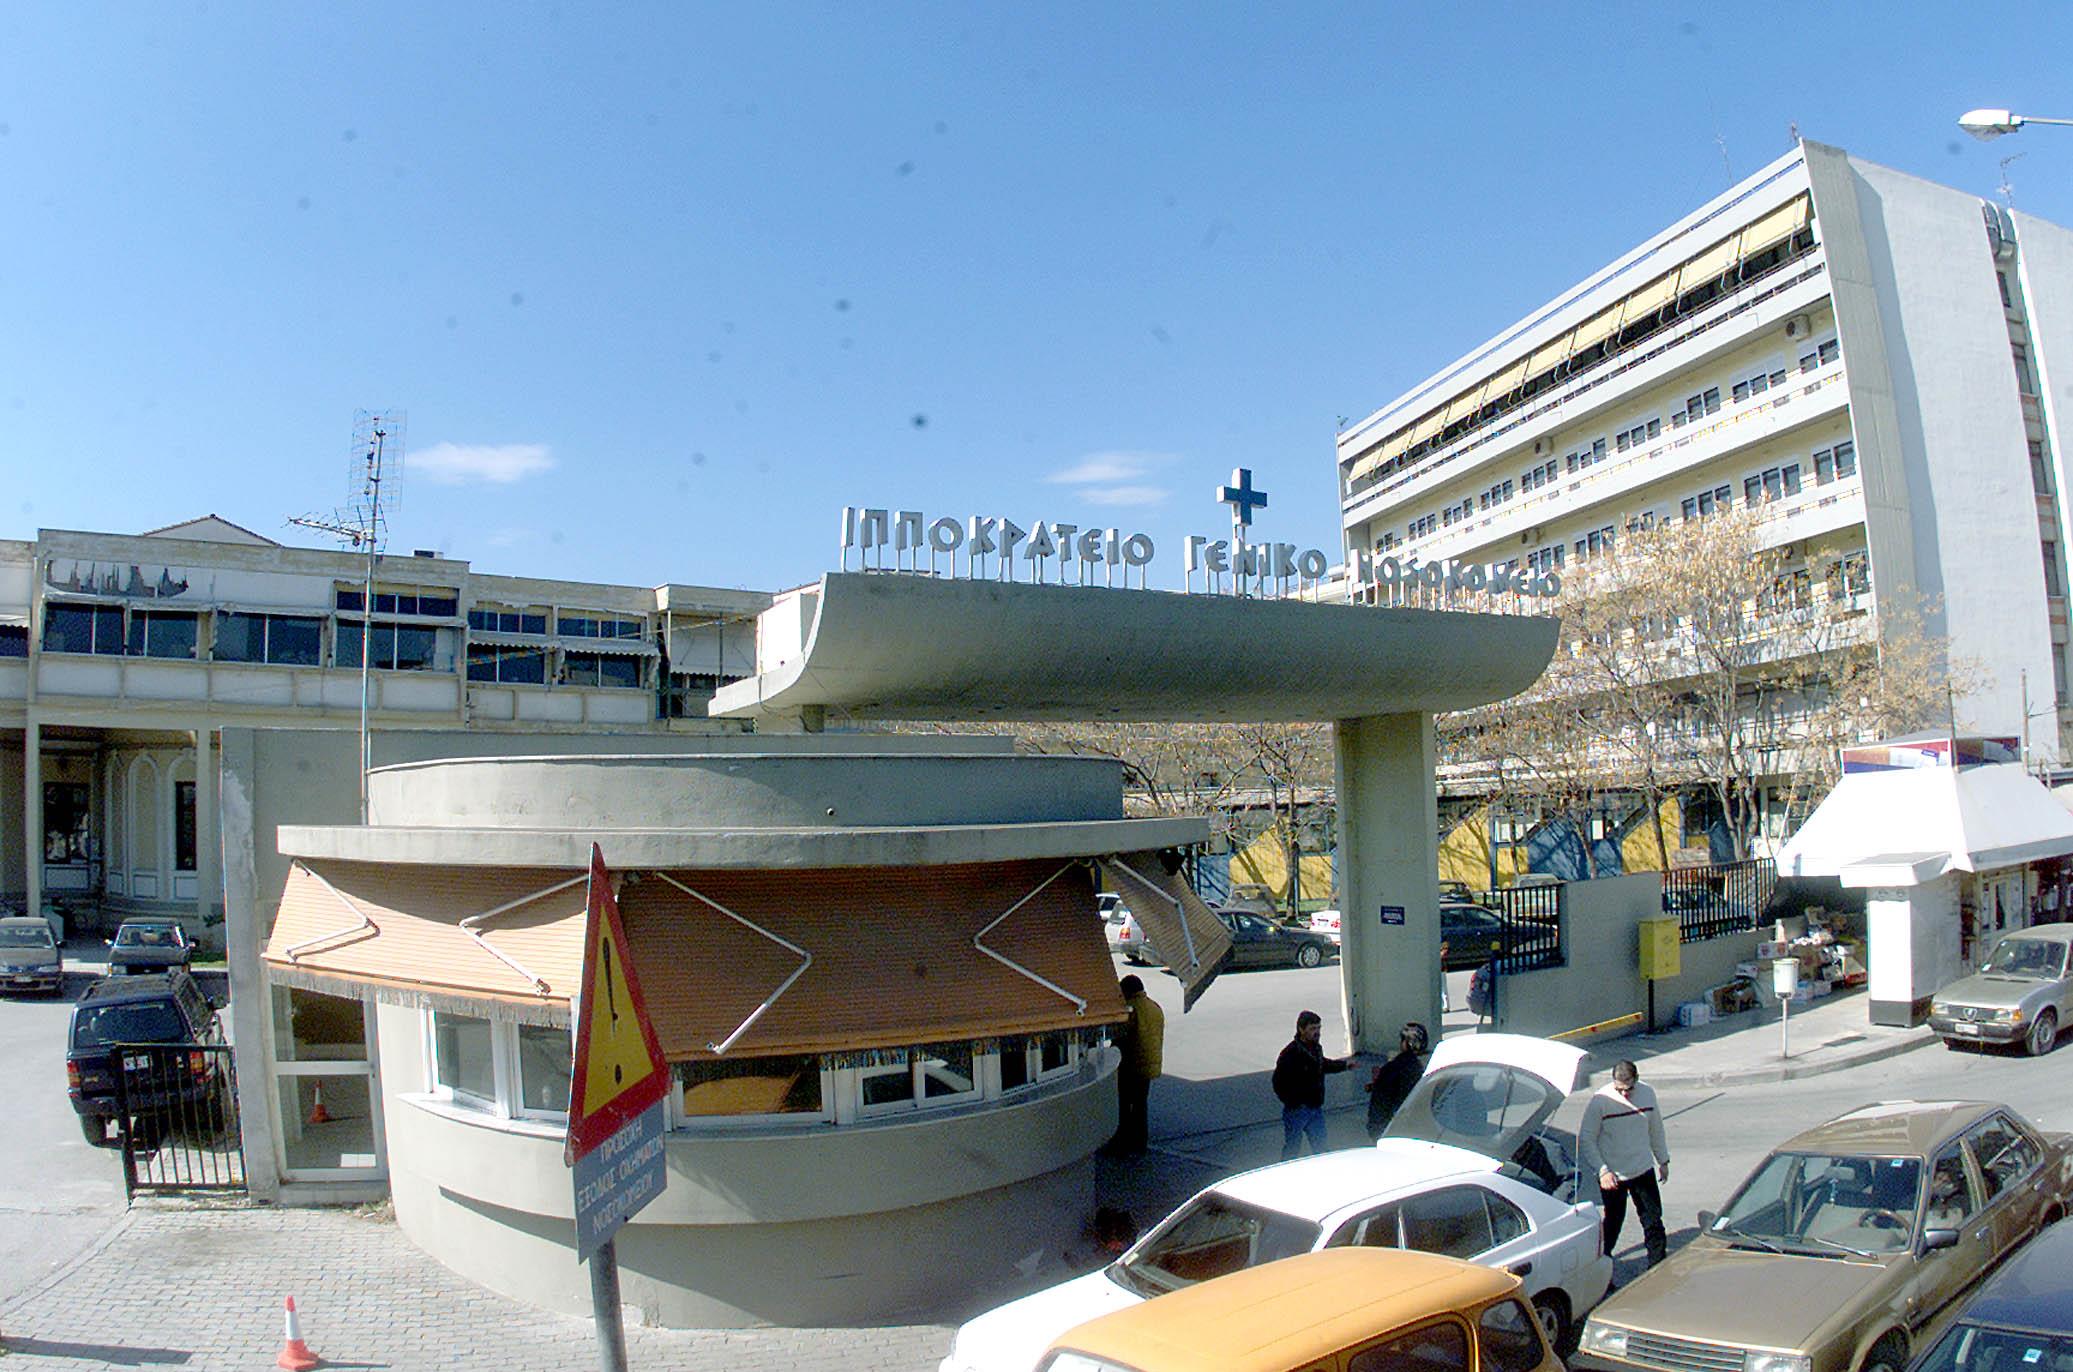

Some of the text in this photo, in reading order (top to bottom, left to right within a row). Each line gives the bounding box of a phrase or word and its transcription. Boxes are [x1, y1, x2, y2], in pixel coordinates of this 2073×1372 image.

[841, 507, 1562, 598] ΙΠΠΟΚΡΑΤΕΙΟ ΓΕΝΙΚΟ ΝΟΣΟΚΟΜΕΙΟ
